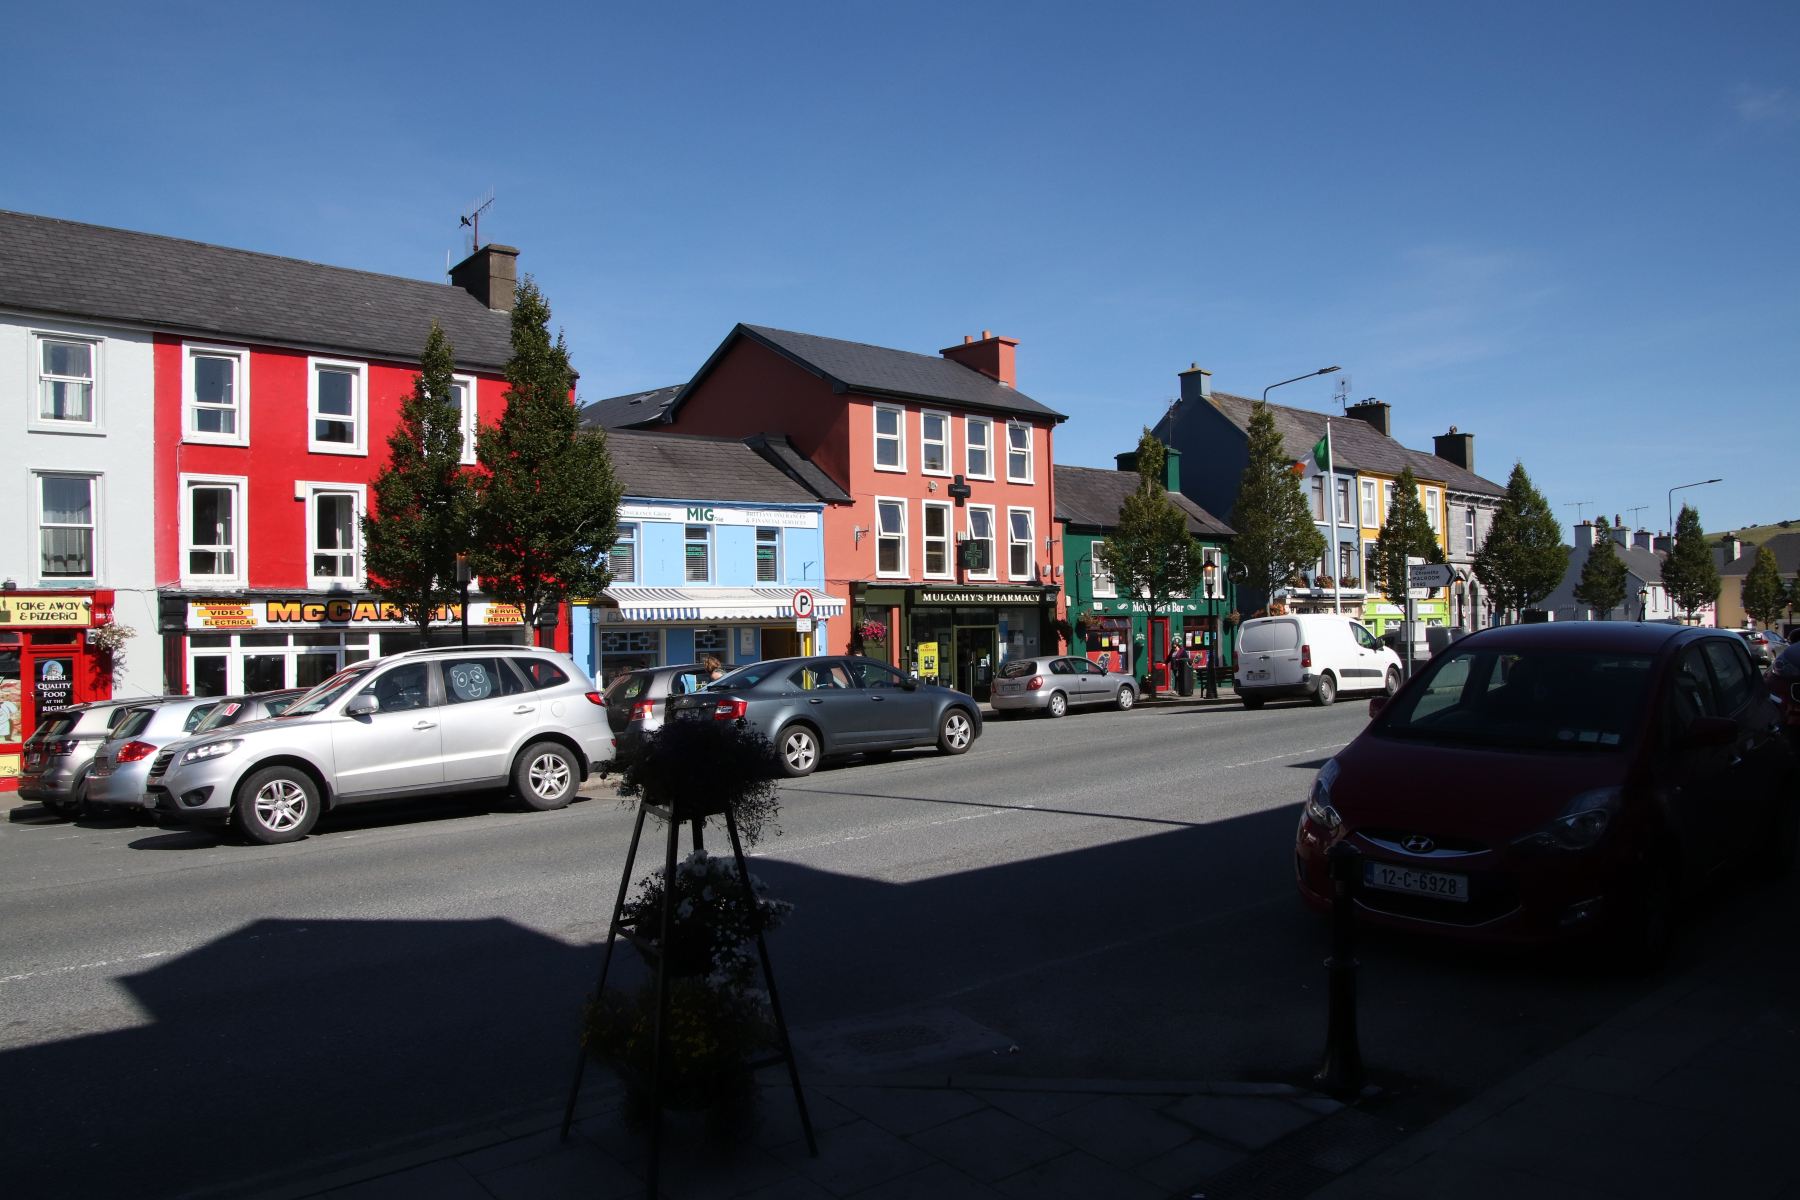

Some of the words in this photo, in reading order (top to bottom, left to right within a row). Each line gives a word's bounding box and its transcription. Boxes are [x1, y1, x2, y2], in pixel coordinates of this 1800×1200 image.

[687, 508, 715, 521] MIG
[922, 593, 984, 602] MULCAHY'S
[986, 593, 1040, 602] PHARMACY
[800, 595, 809, 613] P
[1171, 601, 1184, 613] Bar
[20, 612, 28, 620] &
[1382, 868, 1457, 895] 12-C-6928
